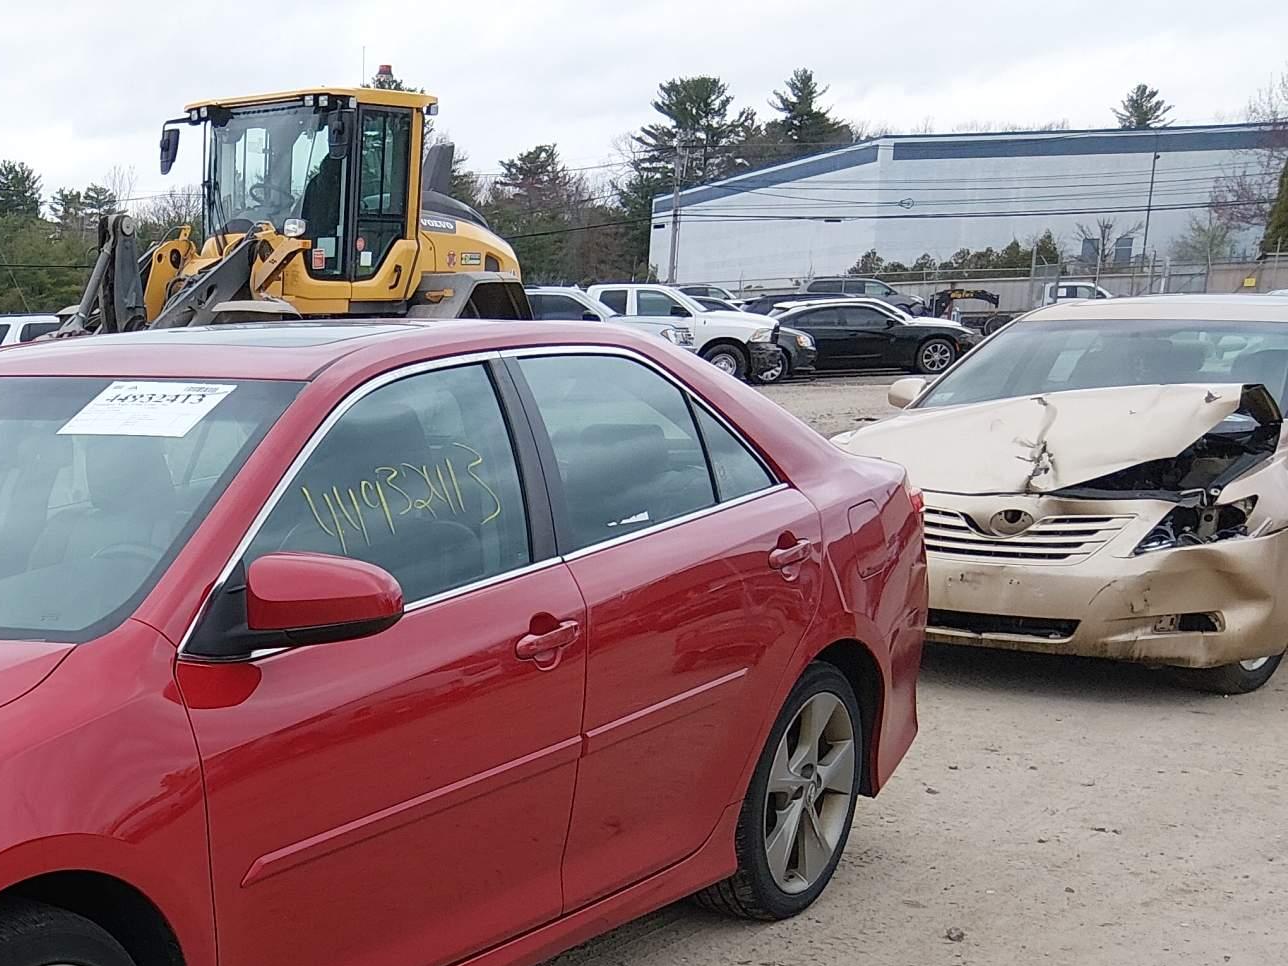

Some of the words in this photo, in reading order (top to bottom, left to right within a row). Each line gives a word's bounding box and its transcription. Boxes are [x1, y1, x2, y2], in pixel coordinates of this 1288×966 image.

[420, 218, 454, 230] VOLVO
[105, 393, 206, 404] 44932413
[301, 442, 501, 555] 44932413
